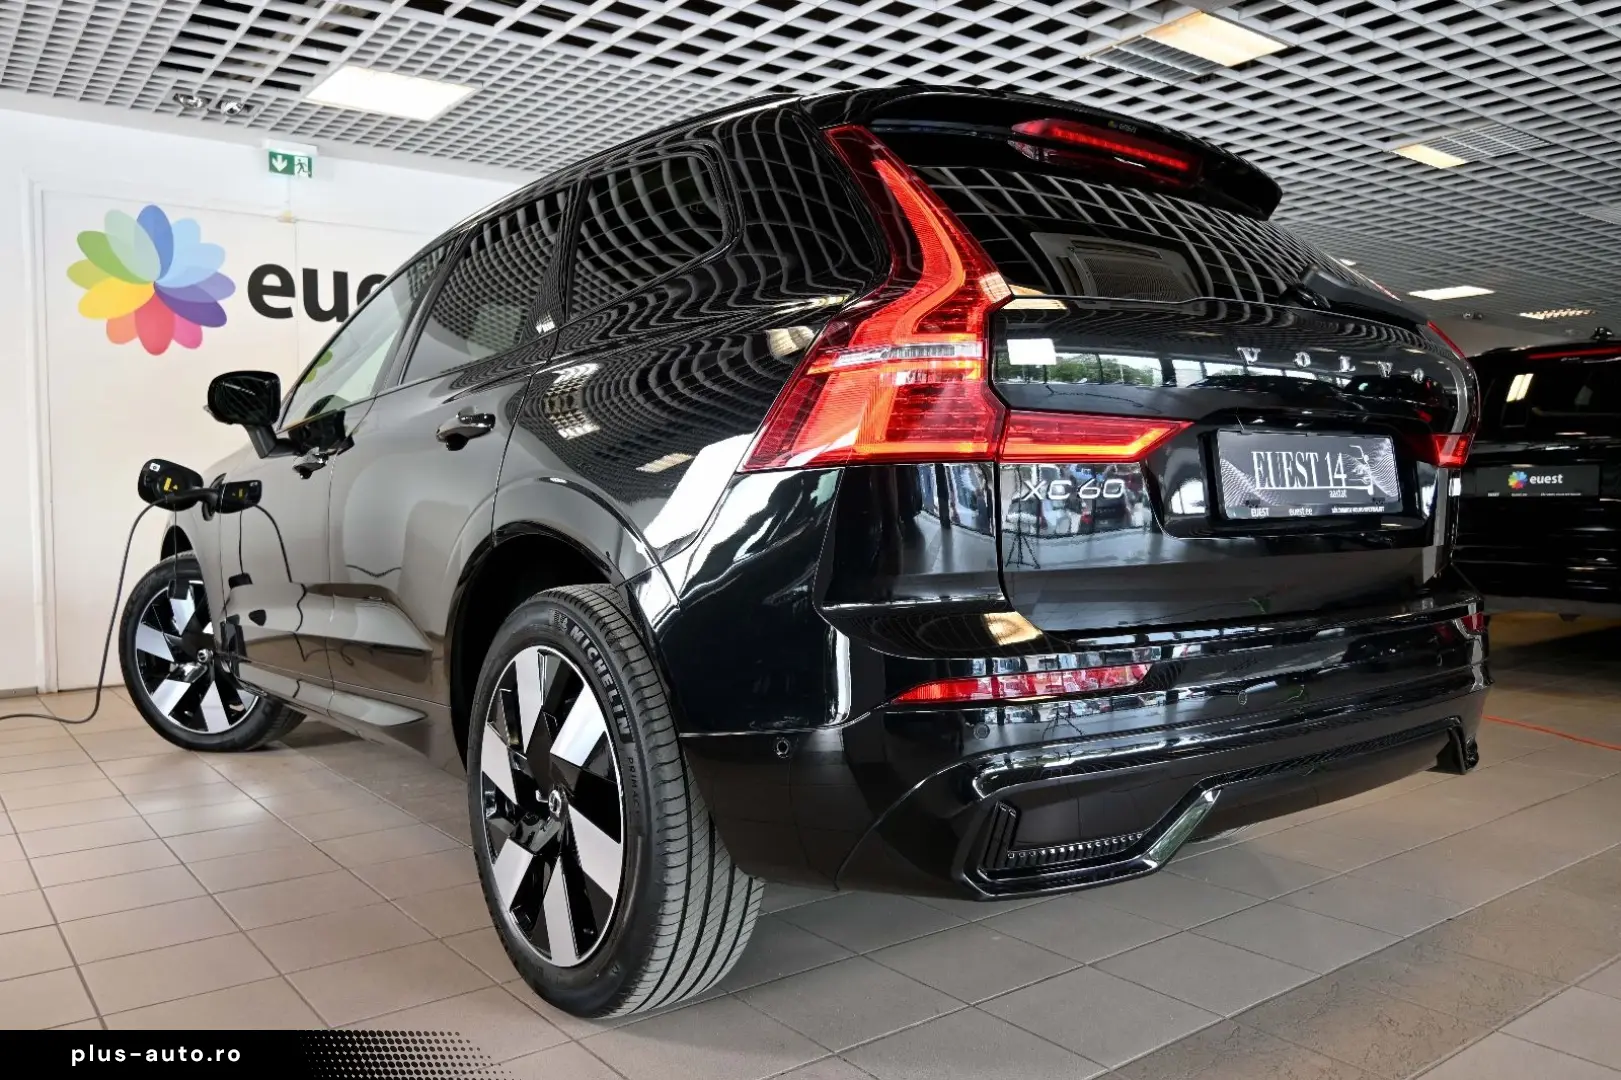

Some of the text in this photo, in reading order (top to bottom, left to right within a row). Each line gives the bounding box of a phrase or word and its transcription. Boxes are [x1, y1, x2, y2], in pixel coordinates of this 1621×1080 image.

[1237, 347, 1425, 383] VOLVO
[1251, 450, 1347, 488] EUEST 14
[1529, 473, 1563, 484] euest
[569, 624, 631, 736] MICHELIN
